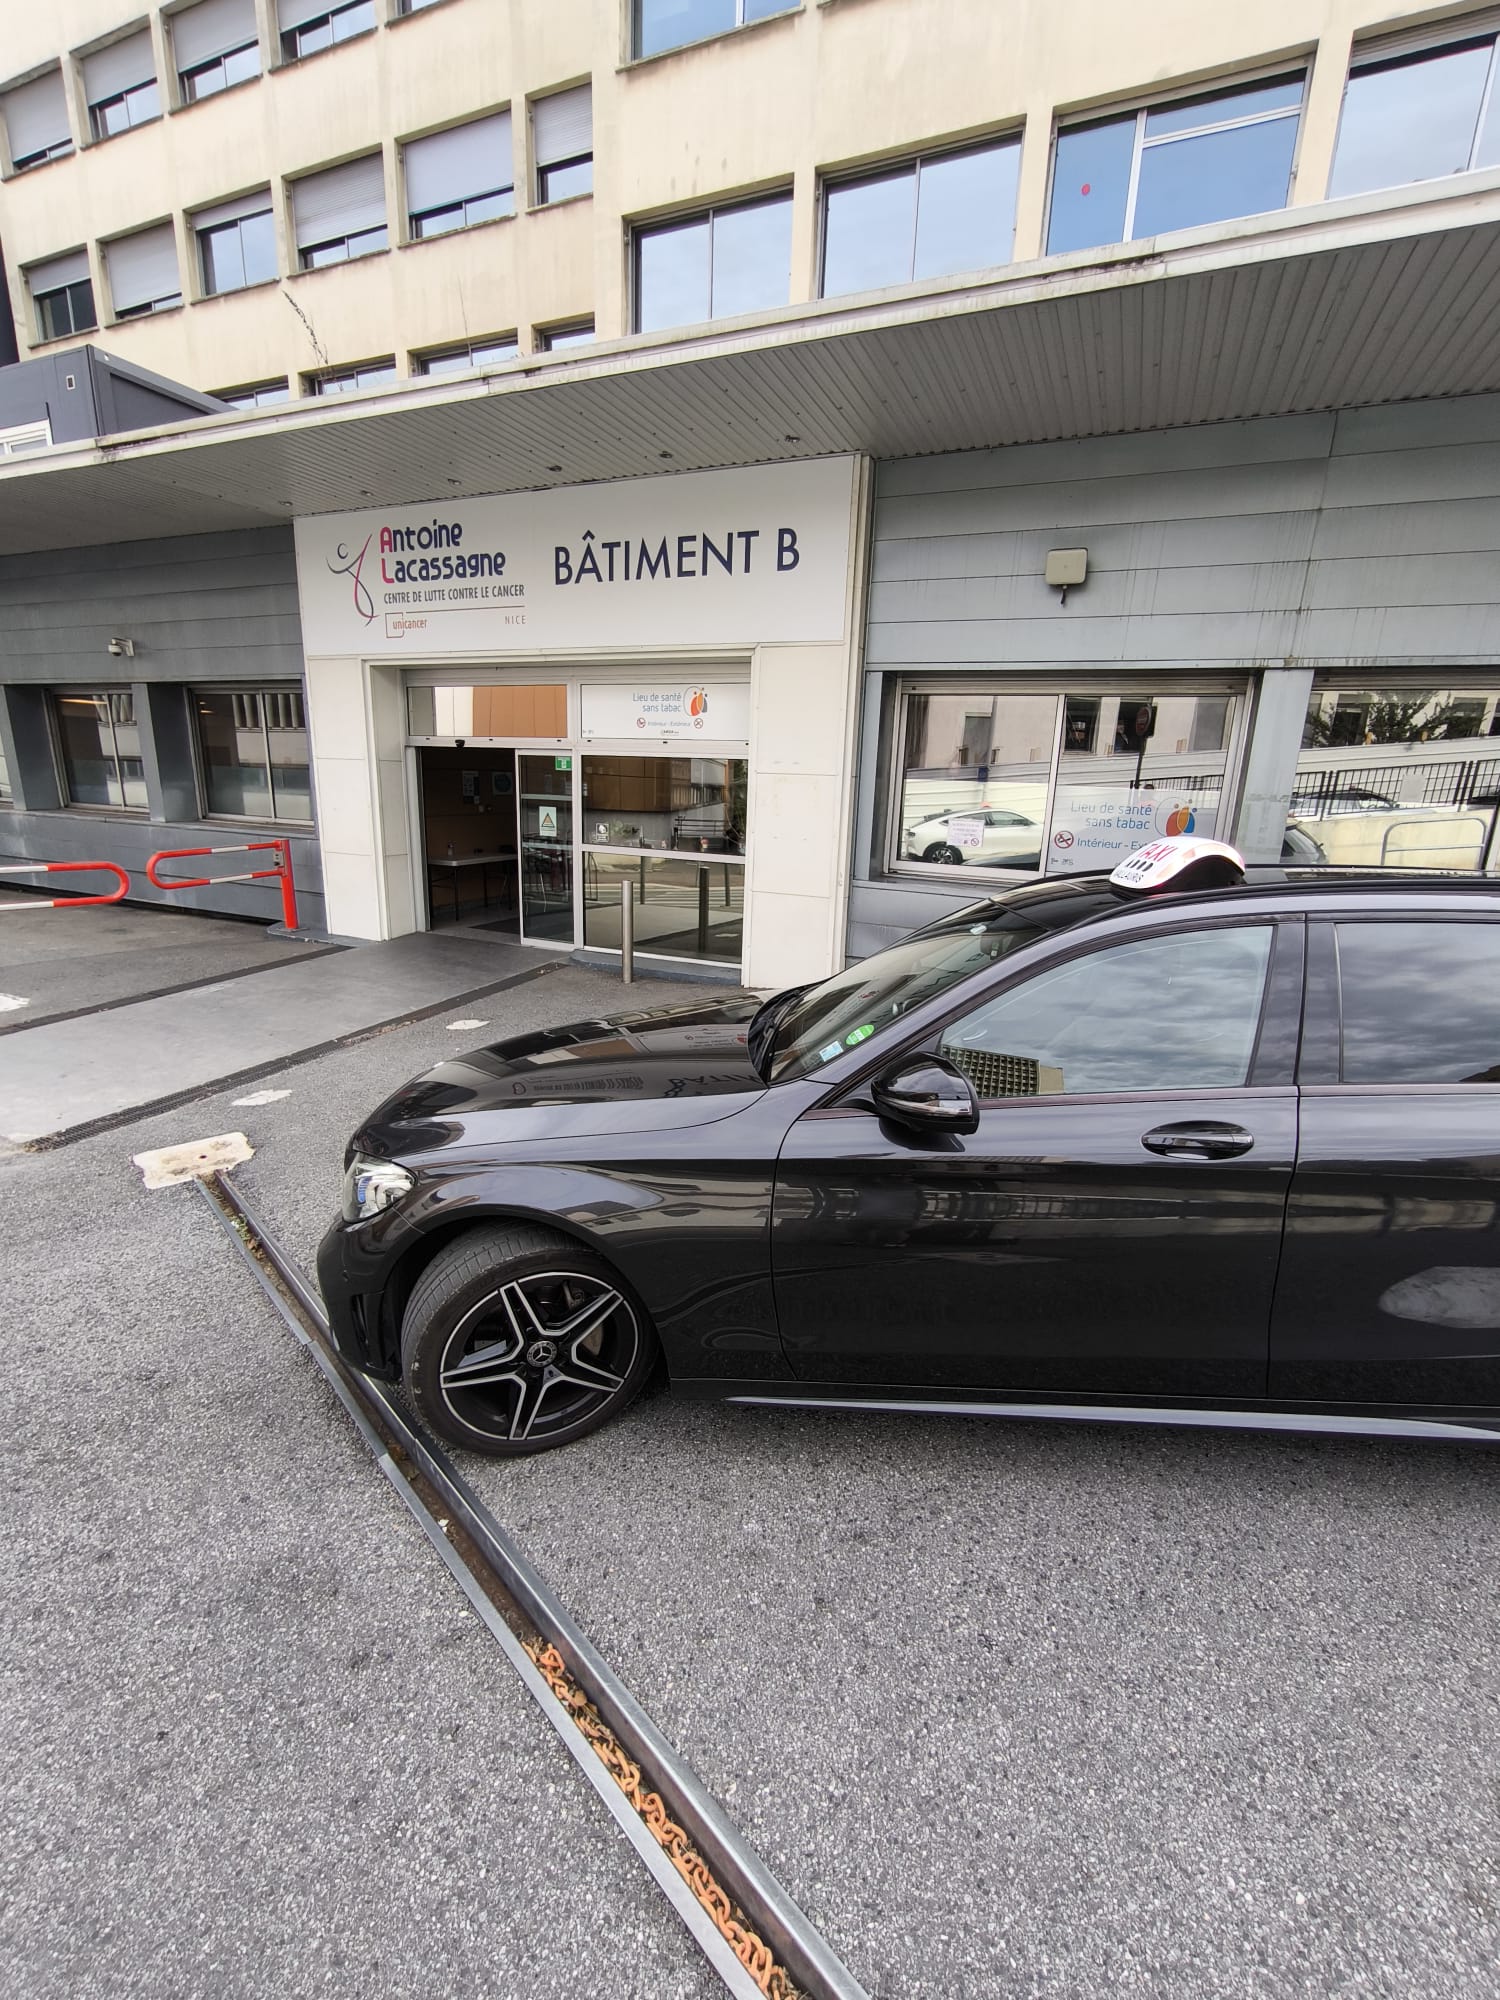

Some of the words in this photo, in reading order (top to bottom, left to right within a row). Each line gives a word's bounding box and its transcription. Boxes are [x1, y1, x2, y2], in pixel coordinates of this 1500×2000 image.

[380, 518, 463, 554] Antoine
[554, 529, 760, 586] BÂTIMENT
[776, 527, 800, 572] B
[381, 551, 506, 584] Lacassagne
[383, 591, 410, 604] CENTRE
[412, 590, 422, 602] DE
[424, 588, 446, 602] LUTTE
[447, 586, 478, 600] CONTRE
[480, 586, 490, 598] LE
[491, 584, 525, 597] CANCER
[392, 618, 427, 630] unicancer
[504, 615, 526, 625] NICE
[632, 692, 648, 702] Lieu
[650, 692, 659, 702] de
[660, 692, 682, 702] santé
[1071, 801, 1096, 813] Lieu
[1099, 802, 1114, 814] de
[1118, 804, 1152, 816] santé
[1085, 817, 1112, 828] sans
[1116, 816, 1151, 830] tabac
[1076, 837, 1122, 849] Intérieur
[1137, 843, 1178, 863] TAXI
